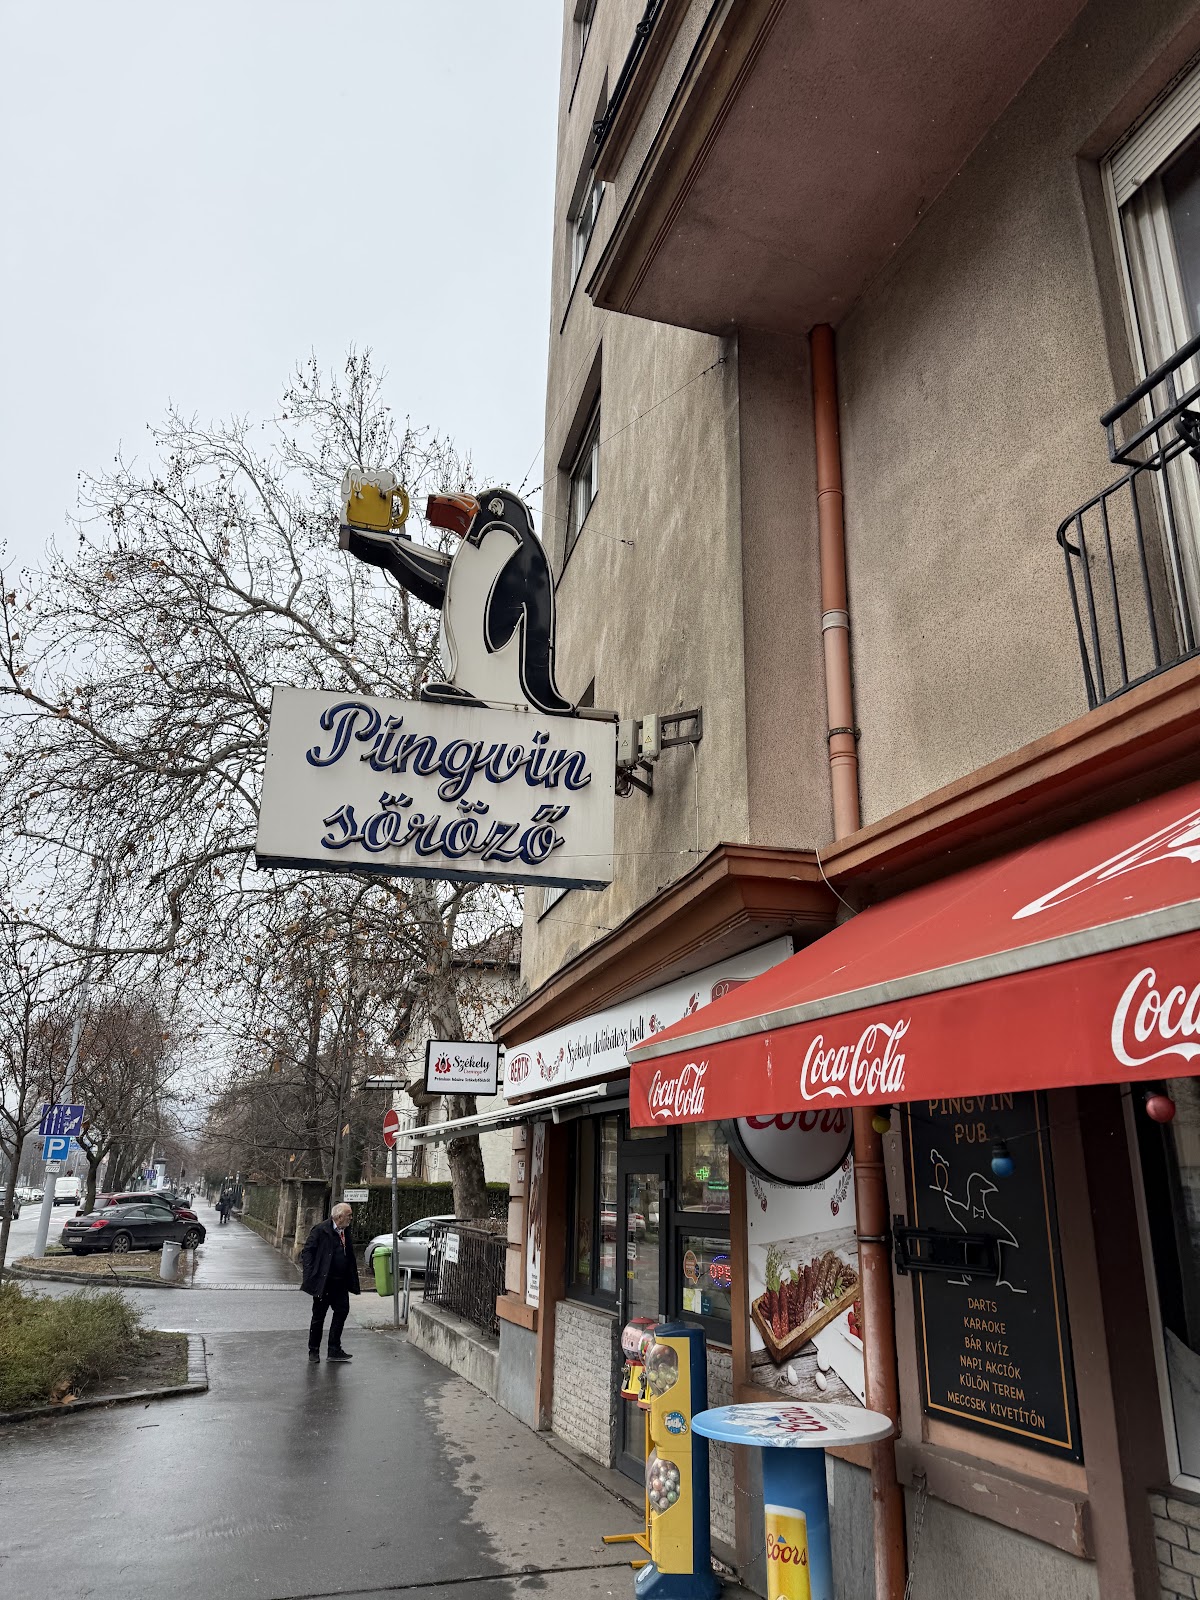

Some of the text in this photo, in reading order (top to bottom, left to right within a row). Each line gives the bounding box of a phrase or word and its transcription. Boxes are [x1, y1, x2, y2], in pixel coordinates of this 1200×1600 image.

[306, 700, 592, 801] Pingvin
[320, 791, 571, 866] söröző
[566, 1034, 592, 1071] Székely
[629, 1015, 646, 1043] bolt
[452, 1055, 491, 1073] Székely
[510, 1056, 529, 1082] BERTIS
[801, 1016, 911, 1101] Coca-Cola
[648, 1059, 710, 1120] Coca-Cola
[927, 1093, 1015, 1117] PINGVIN
[954, 1122, 987, 1145] PUB
[47, 1138, 66, 1158] P
[709, 1263, 731, 1282] OPE
[967, 1297, 998, 1313] DARTS
[963, 1316, 1007, 1335] KARAOKE
[964, 1334, 1010, 1357] BÁR KVÍZ
[960, 1354, 1022, 1380] NAPI AKCIÓK
[960, 1373, 1026, 1401] KÜLÖN TEREM
[947, 1390, 1046, 1429] MECCSEK KIVETÍTŐN
[766, 1533, 808, 1566] Coors
